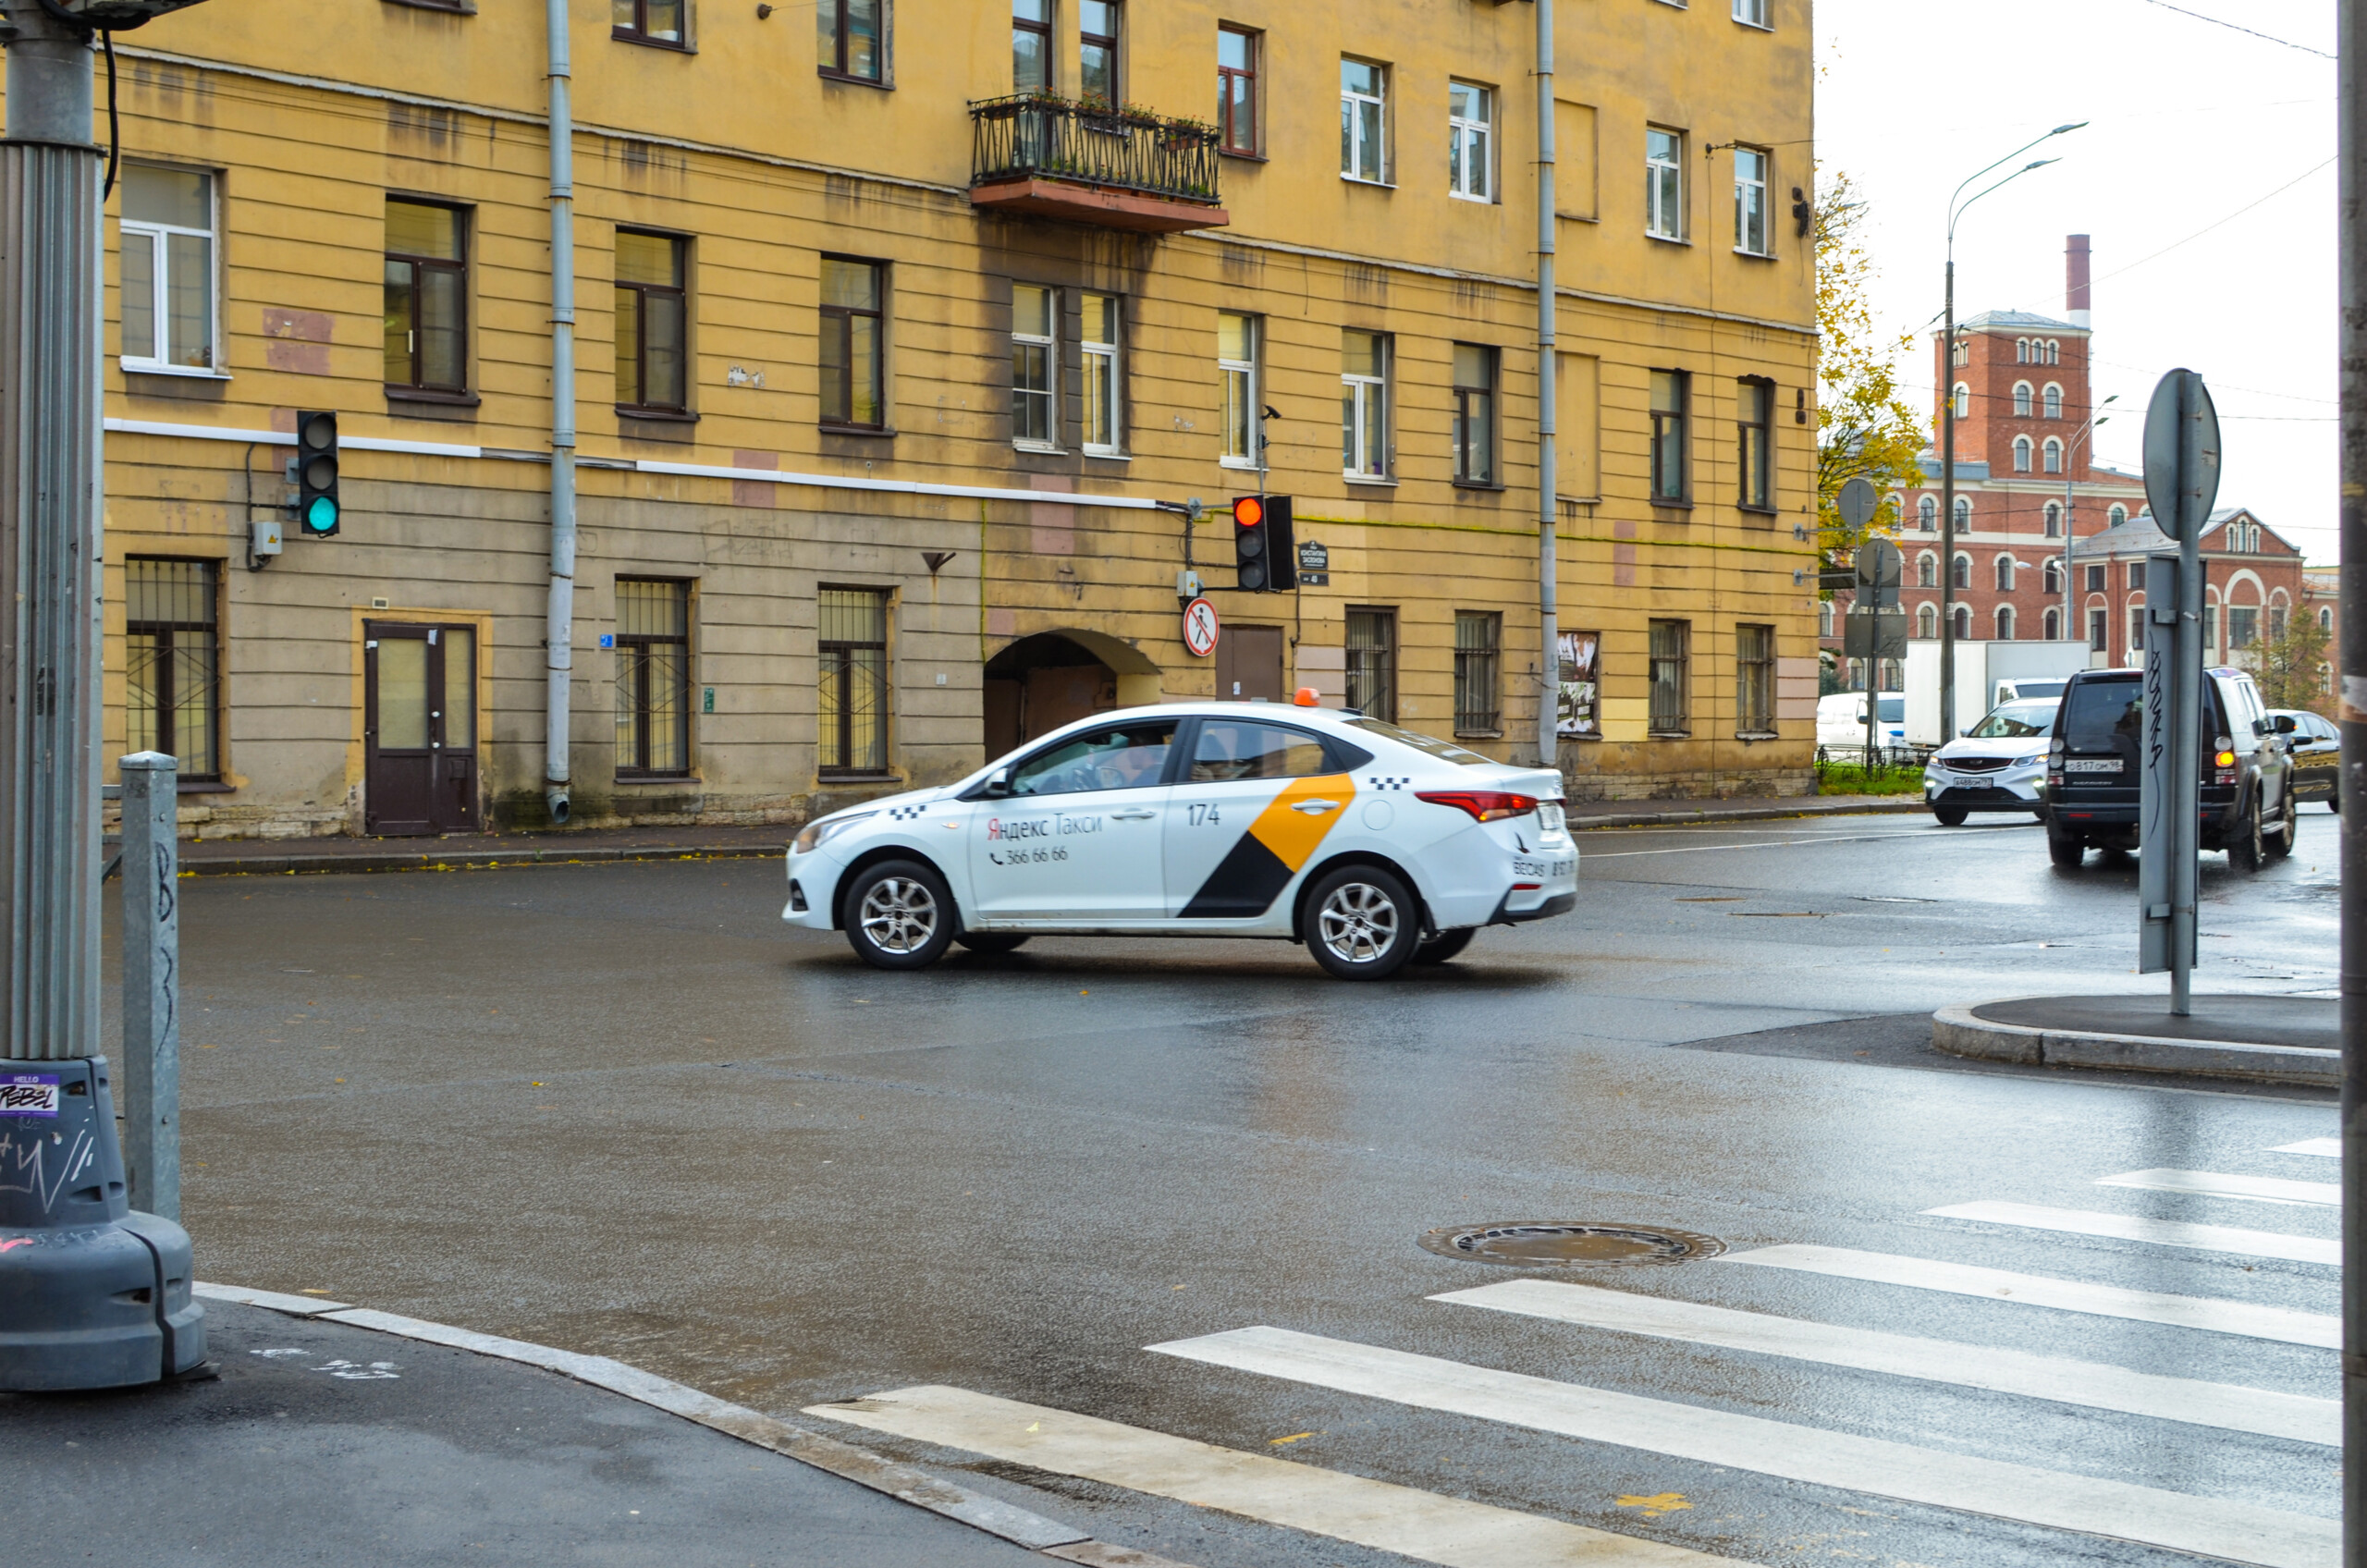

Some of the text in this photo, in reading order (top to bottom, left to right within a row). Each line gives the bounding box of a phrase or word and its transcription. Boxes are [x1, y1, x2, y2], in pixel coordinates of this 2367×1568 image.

[1187, 803, 1220, 827] 174
[987, 813, 1102, 841] Яндекс Такси
[1006, 845, 1069, 865] 366 66 66
[13, 1075, 40, 1084] HELLO
